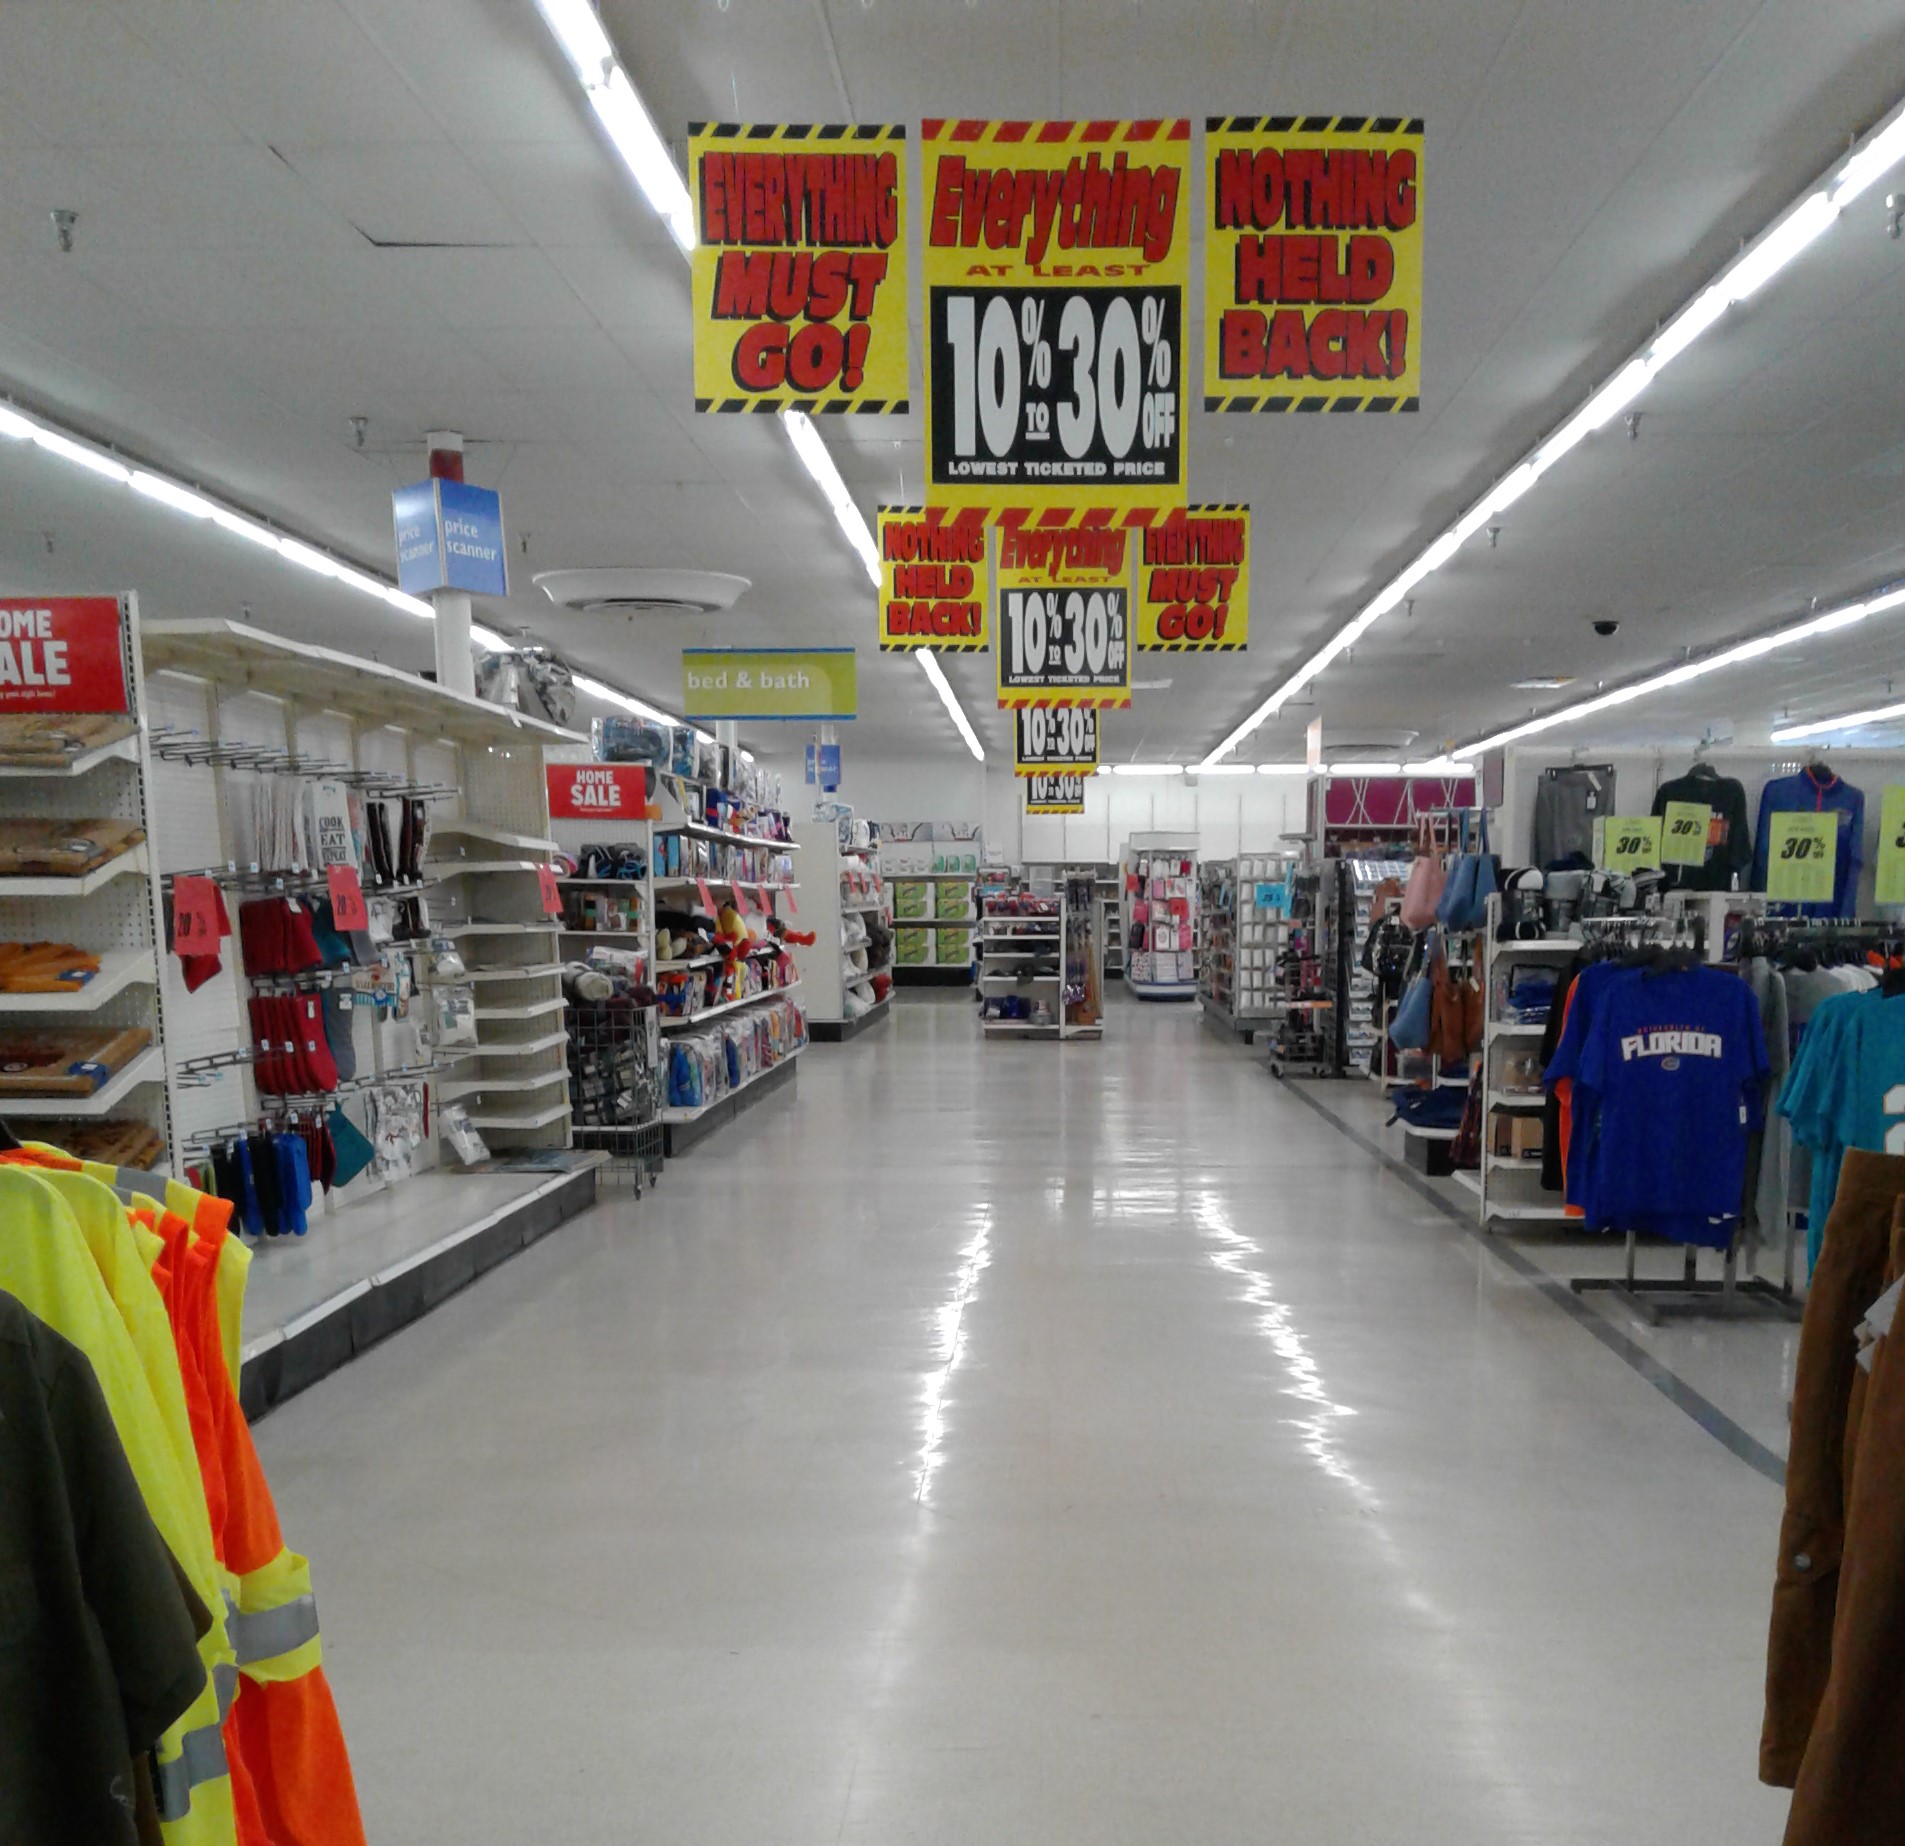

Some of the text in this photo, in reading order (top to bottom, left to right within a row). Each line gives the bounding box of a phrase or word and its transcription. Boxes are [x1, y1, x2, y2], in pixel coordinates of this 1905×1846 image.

[699, 152, 898, 250] EVERYTHING
[929, 151, 1181, 265] Everything
[1215, 147, 1417, 232] NOTHING
[711, 250, 889, 322] MUST
[966, 264, 1150, 277] AT LEAST
[1235, 234, 1395, 305] HELD
[731, 321, 872, 394] GO!
[1219, 308, 1408, 381] BACK!
[1025, 402, 1050, 440] TO
[1142, 391, 1175, 449] OFF
[948, 461, 1165, 476] LOWEST TICKETED PRICE
[444, 517, 478, 538] price
[883, 521, 985, 563] NOTHING
[1143, 518, 1246, 566] EVERYTHING
[446, 541, 497, 561] scanner
[1000, 526, 1126, 578] Everything
[894, 564, 974, 599] HELD
[1147, 567, 1239, 604] MUST
[0, 609, 52, 638] OME
[887, 601, 982, 636] BACK!
[1157, 602, 1228, 640] GO!
[0, 641, 71, 685] ALE
[1107, 640, 1125, 669] OFF
[687, 672, 810, 689] bed & bath
[571, 784, 621, 807] SALE
[576, 770, 614, 784] HOME
[320, 833, 345, 846] EAT
[1621, 1031, 1722, 1061] FLORIDA
